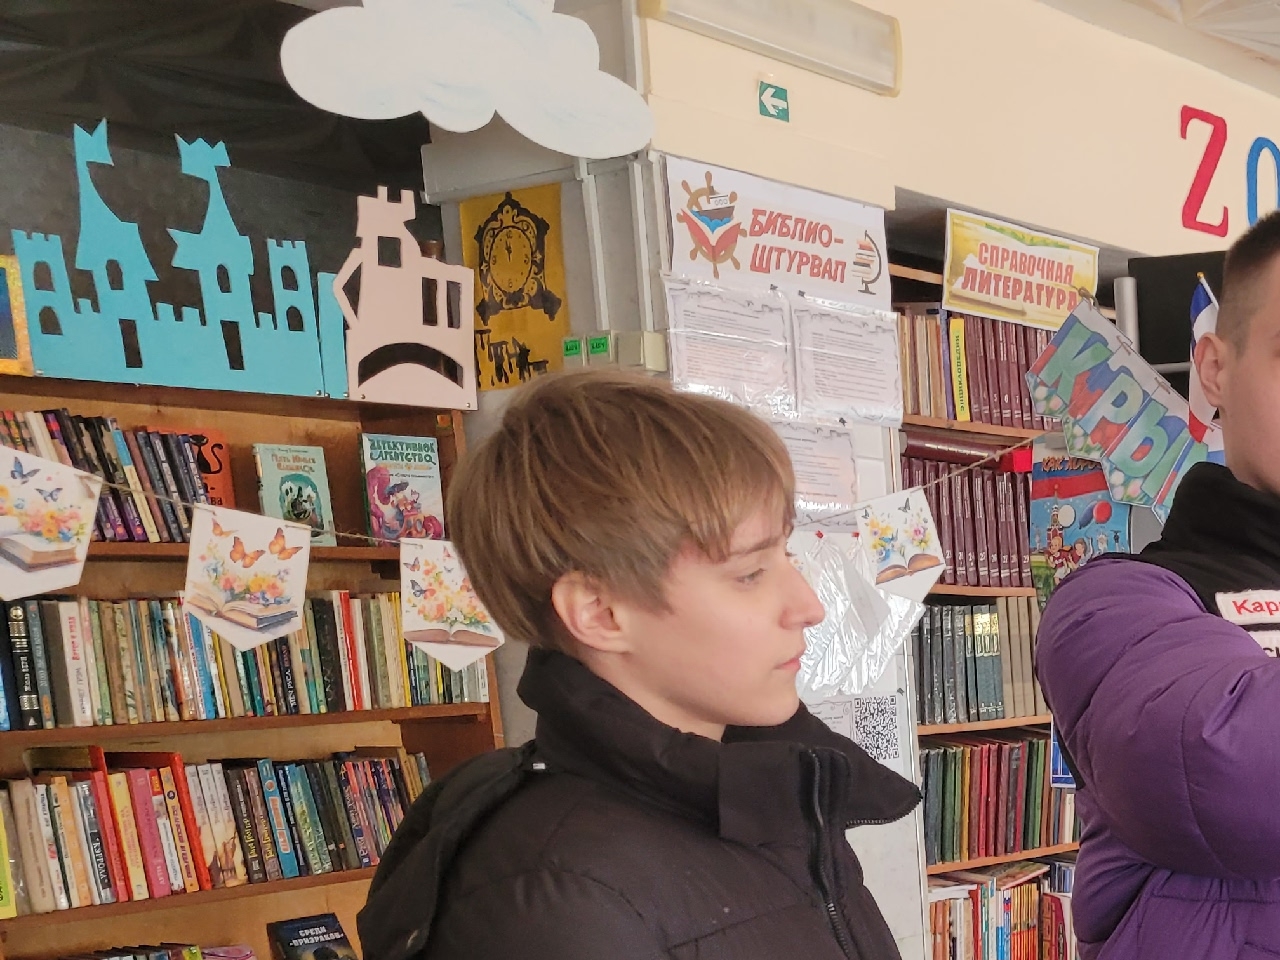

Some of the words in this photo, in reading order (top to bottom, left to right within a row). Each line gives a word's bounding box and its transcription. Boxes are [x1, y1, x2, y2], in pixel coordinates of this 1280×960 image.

[748, 208, 844, 248] БИБЛИО-
[750, 243, 846, 283] ШТУРВАЛ
[977, 242, 1075, 285] СПРАВОЧНАЯ
[961, 266, 1078, 312] ЛИТЕРАТУРА
[1039, 322, 1207, 508] КРЫ
